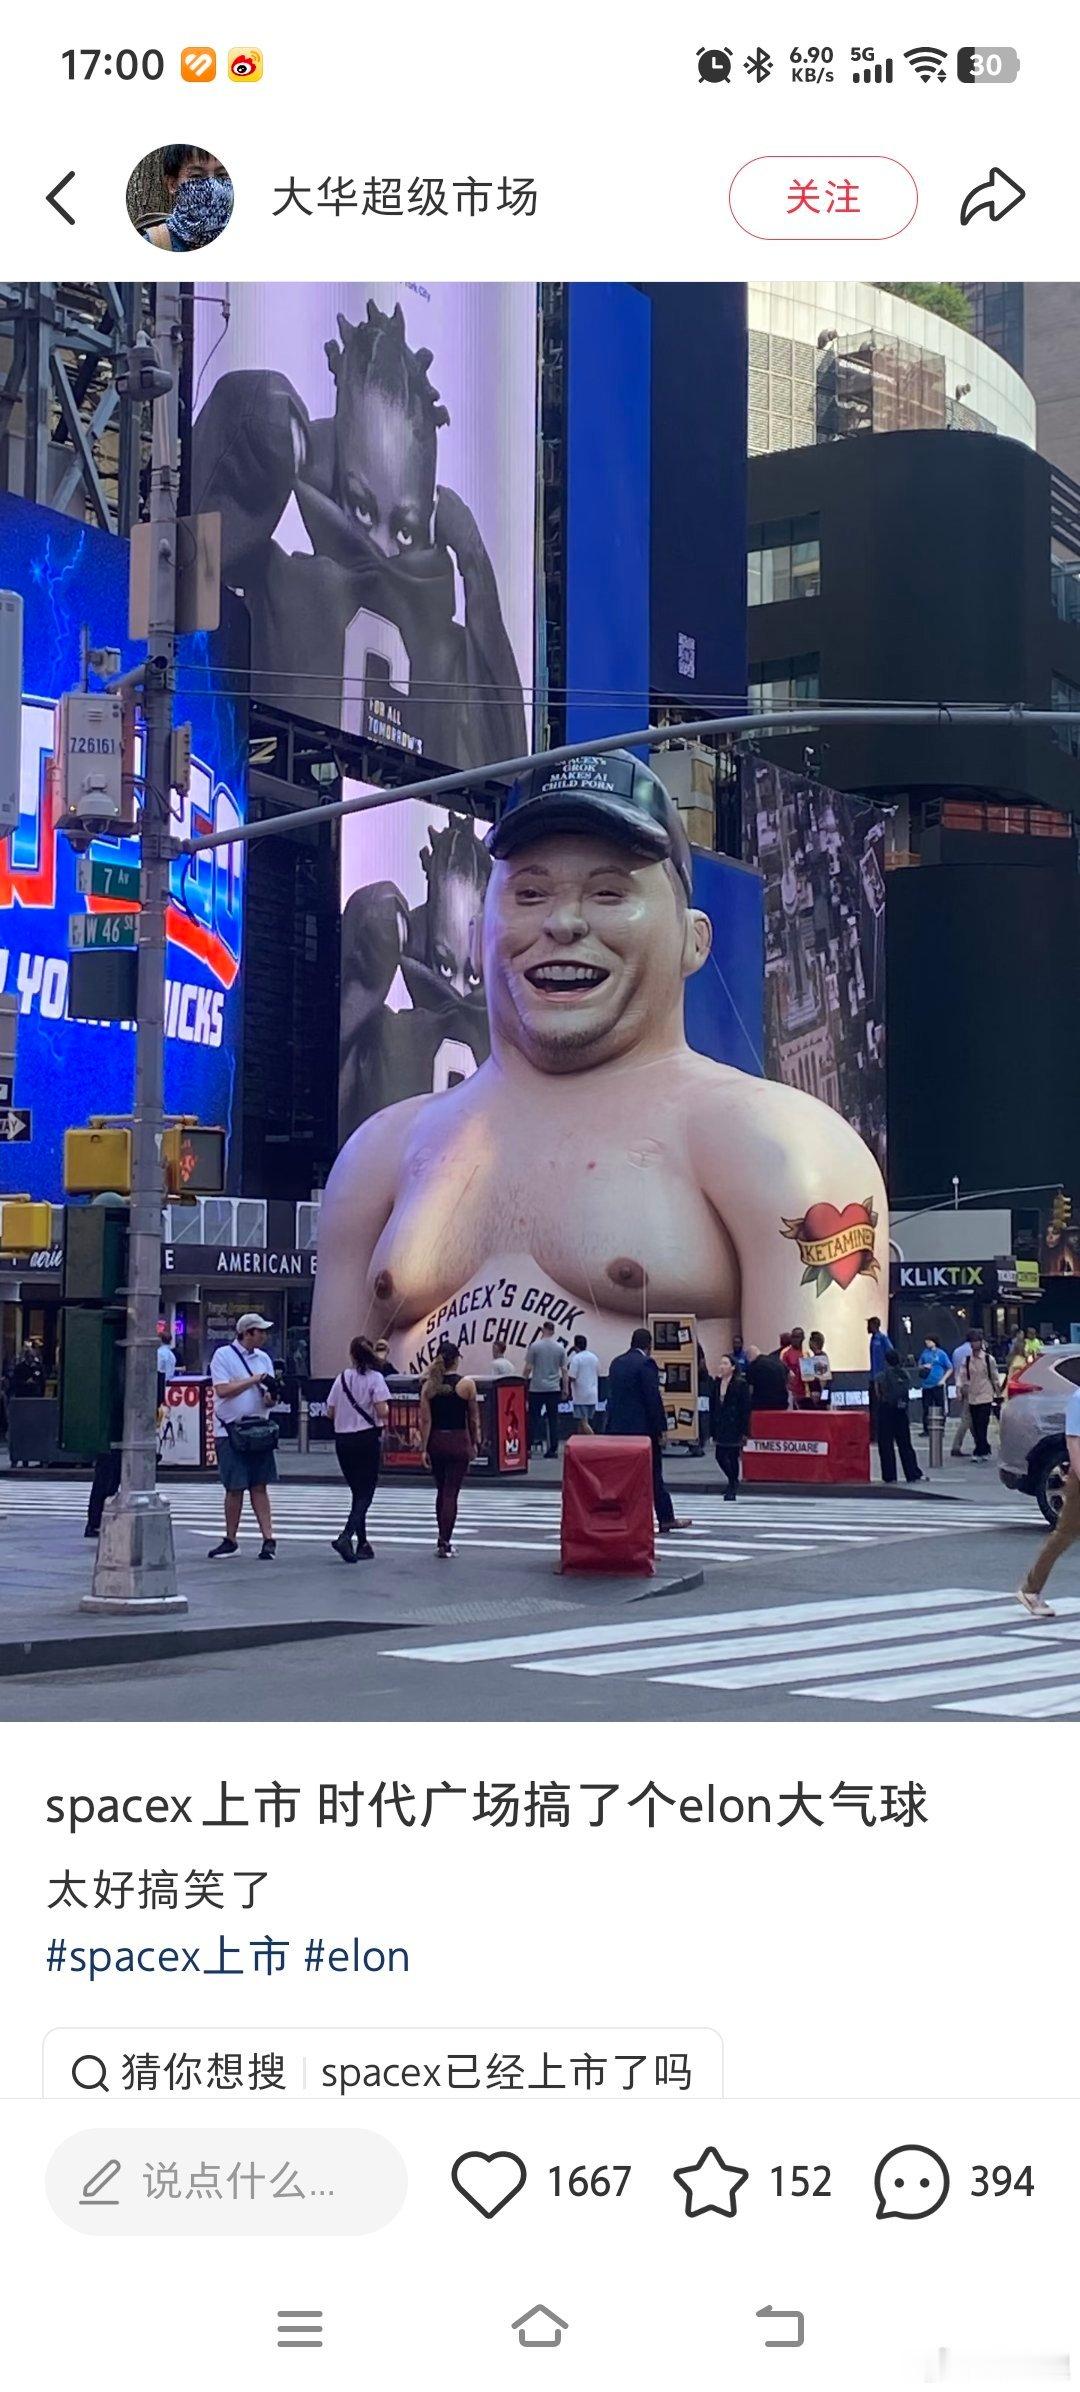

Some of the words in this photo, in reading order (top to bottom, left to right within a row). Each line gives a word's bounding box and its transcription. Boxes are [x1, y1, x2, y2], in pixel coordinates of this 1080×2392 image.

[70, 737, 115, 754] 726161
[550, 772, 592, 782] MAKES
[594, 772, 608, 782] AI
[563, 763, 596, 773] GROK
[541, 780, 578, 792] CHILD
[581, 779, 614, 792] PORN
[103, 867, 113, 894] 7
[86, 917, 98, 944] W
[101, 917, 120, 943] 46
[803, 1226, 873, 1262] KETAMINE
[216, 1251, 302, 1274] AMERICAN
[900, 1266, 984, 1287] KLIKTIX
[425, 1278, 518, 1335] SPACEX'S
[521, 1287, 585, 1331] GROK
[457, 1318, 477, 1348] AI
[752, 1441, 782, 1452] TIMES
[783, 1442, 819, 1453] SQUARE
